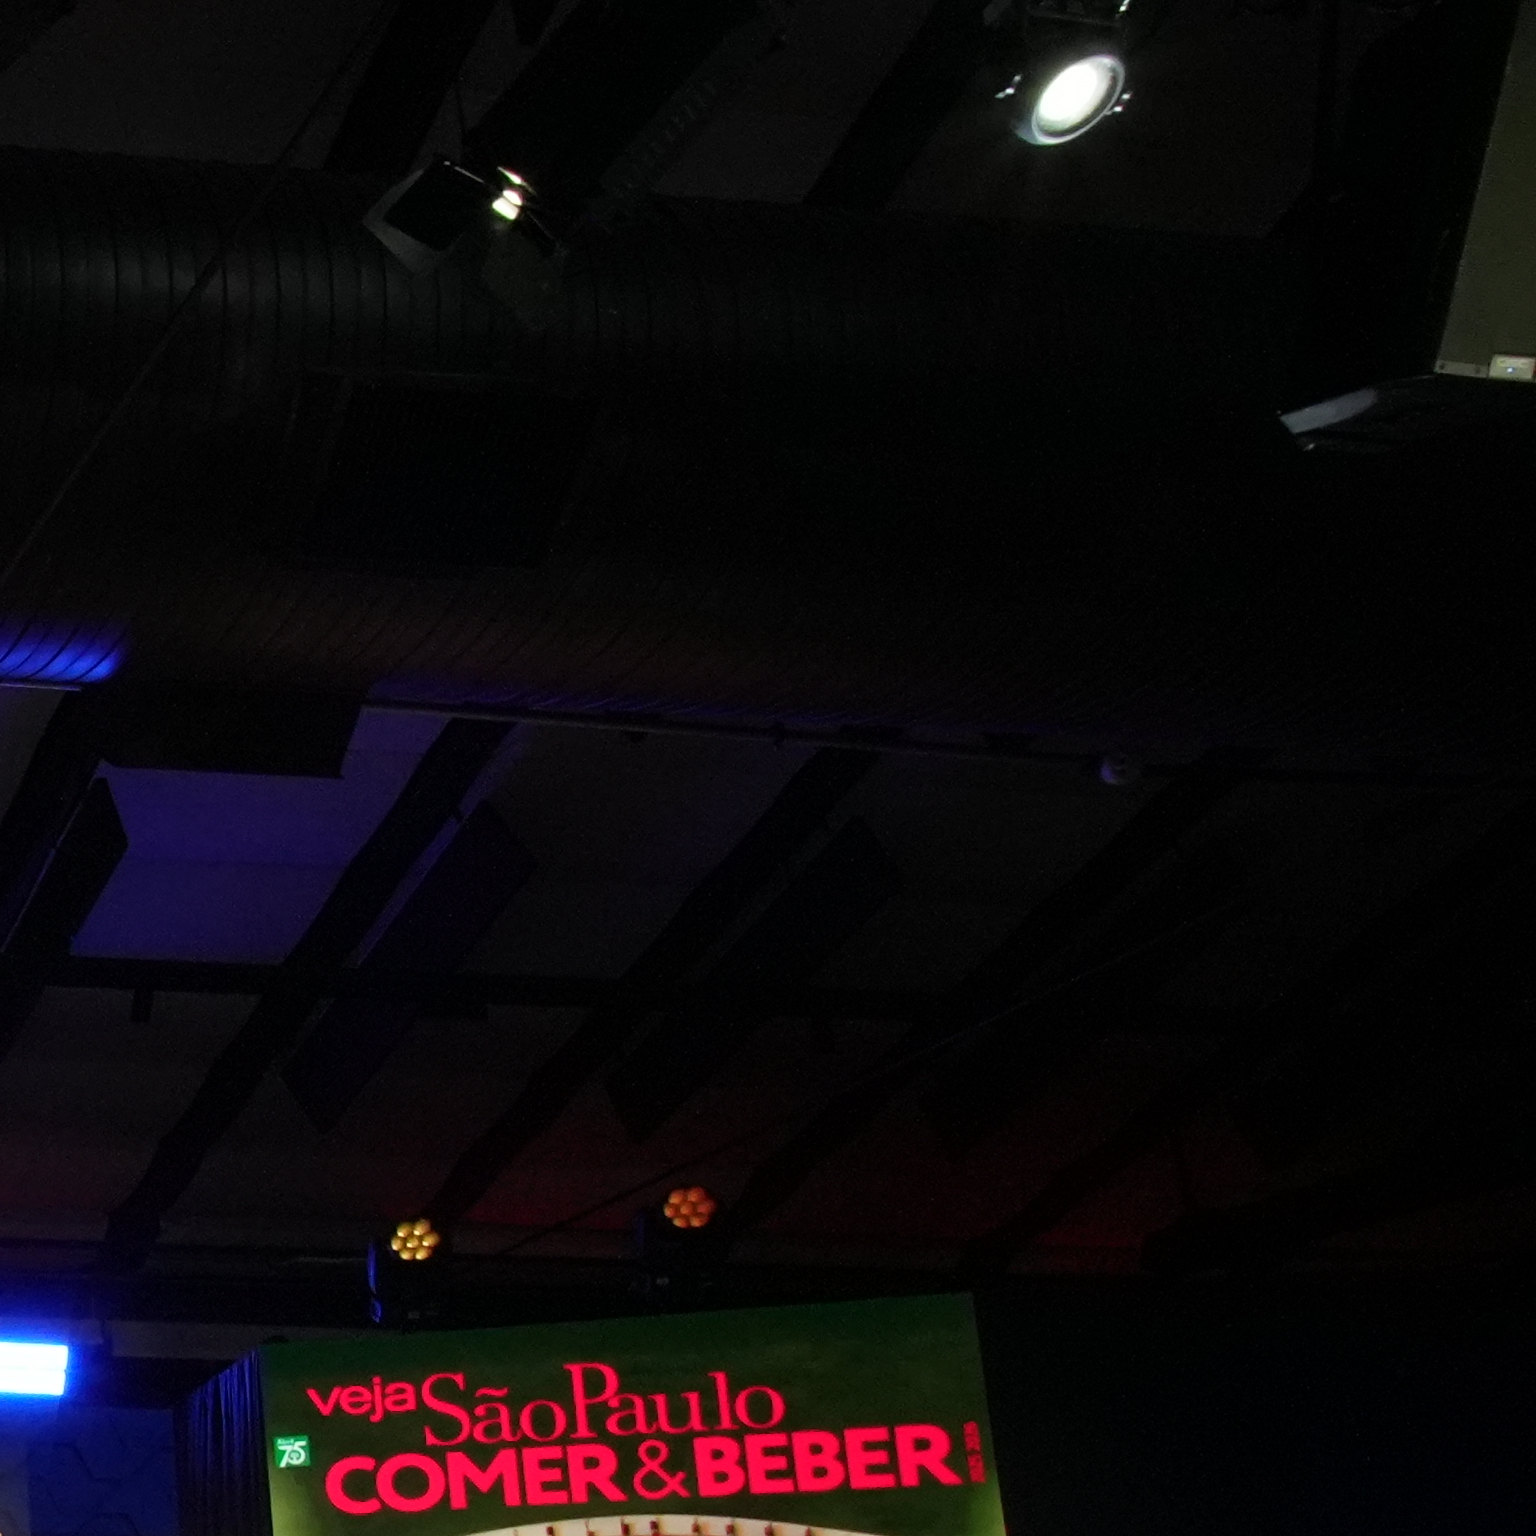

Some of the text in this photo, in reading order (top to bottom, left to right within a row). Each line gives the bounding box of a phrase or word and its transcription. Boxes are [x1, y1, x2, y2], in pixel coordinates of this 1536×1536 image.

[306, 1376, 418, 1423] veja
[325, 1443, 629, 1516] COMER
[633, 1438, 692, 1501] &
[693, 1423, 964, 1498] BEBER
